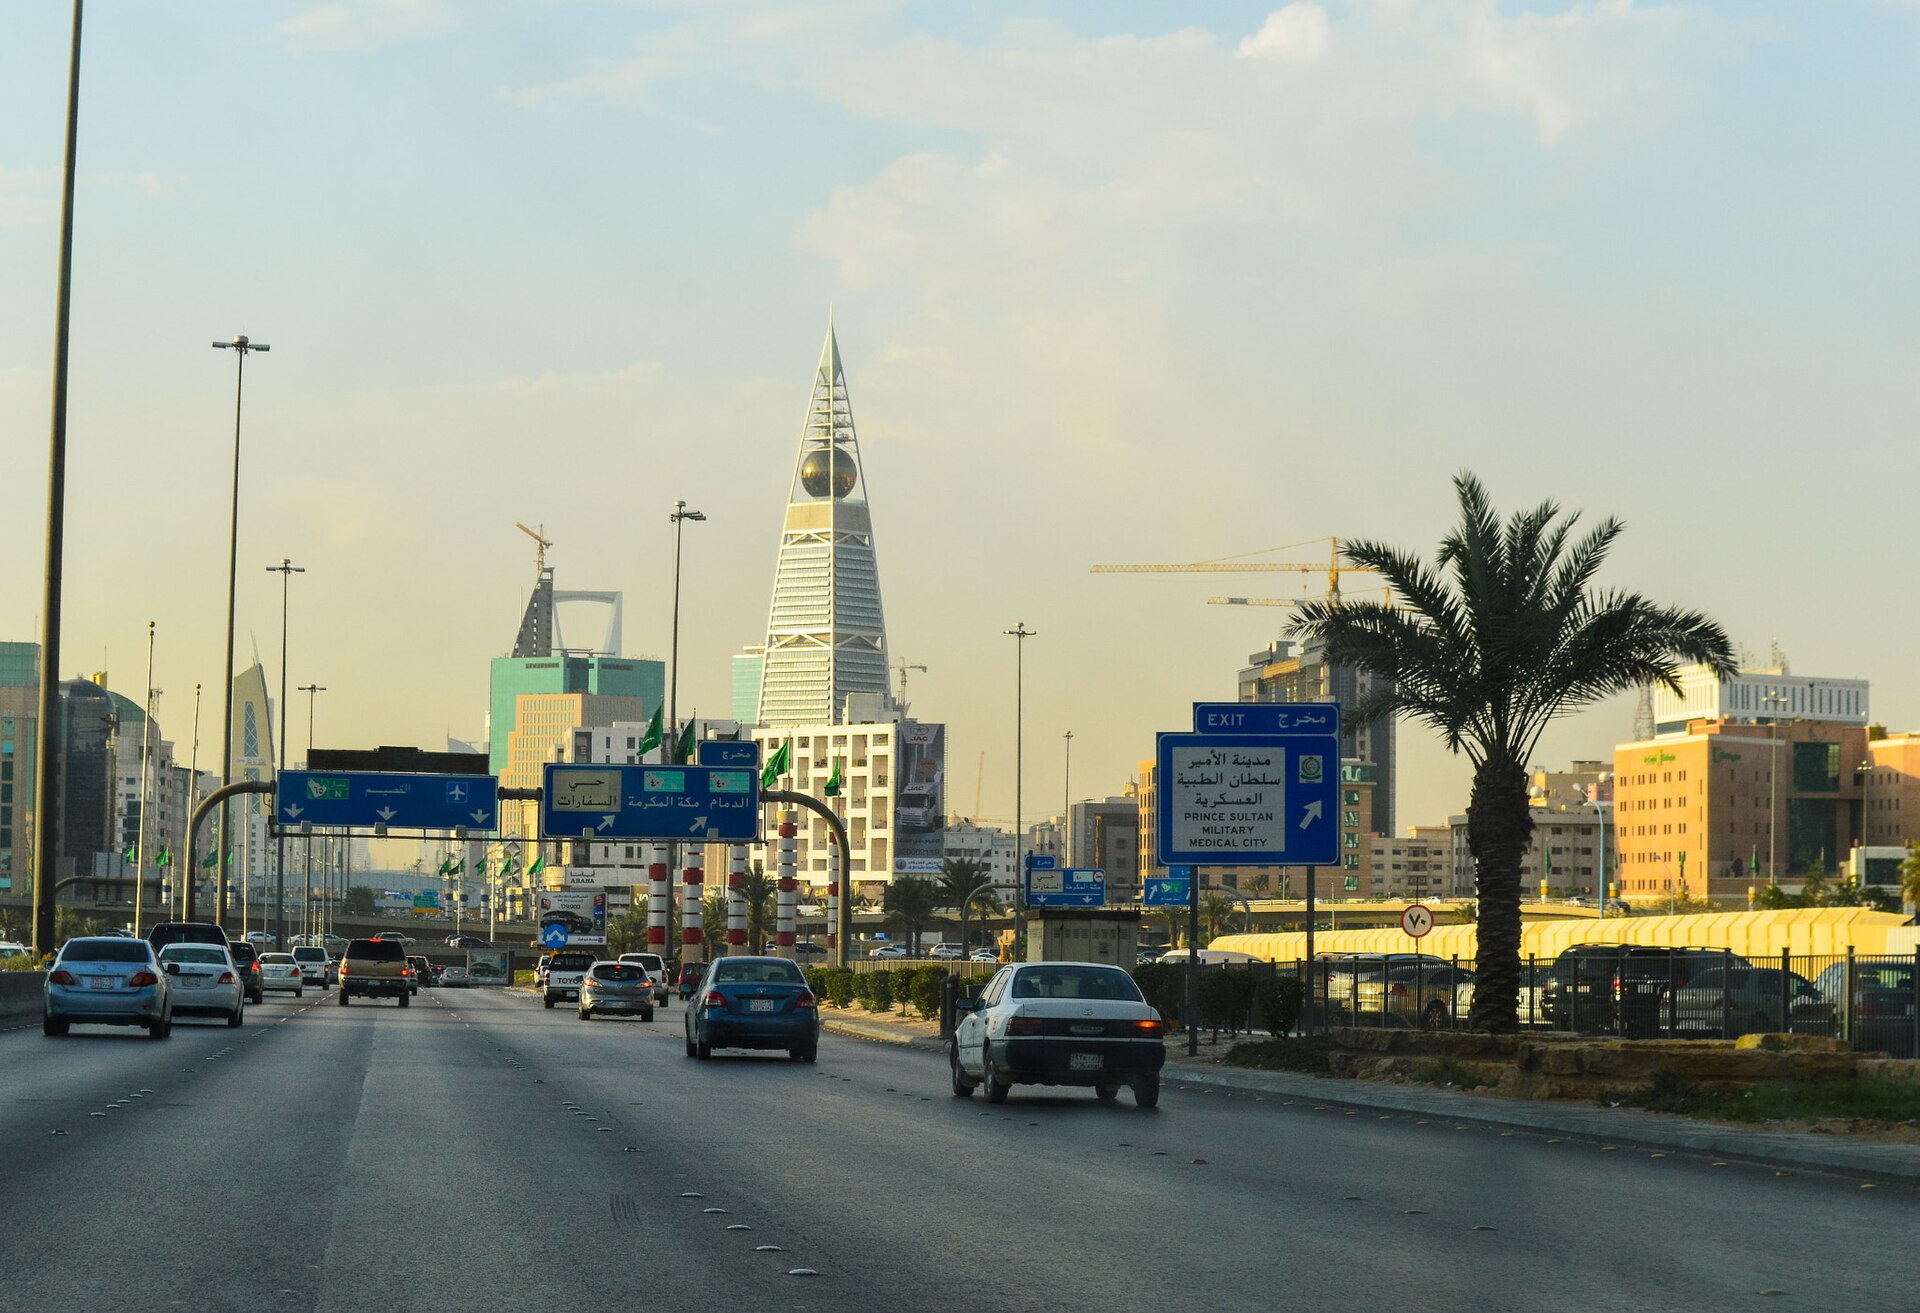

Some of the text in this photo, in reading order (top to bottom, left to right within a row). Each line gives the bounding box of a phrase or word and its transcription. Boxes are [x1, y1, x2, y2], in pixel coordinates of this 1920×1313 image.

[1208, 714, 1245, 726] EXIT
[1278, 712, 1326, 728] مخرج
[722, 749, 750, 760] مخرج
[1188, 749, 1271, 768] مدينة الأمير
[568, 778, 604, 792] حي
[1177, 773, 1280, 788] سلطان الطبية
[365, 784, 410, 798] القصيم
[557, 795, 617, 808] السفارات
[628, 796, 700, 809] مكة المكرمة
[710, 797, 749, 808] الدمام
[1195, 792, 1262, 808] العسكرية
[1184, 812, 1273, 821] PRINCE SULTAN
[1202, 826, 1254, 834] MILITARY
[1190, 839, 1267, 847] MEDICAL CITY
[1409, 912, 1426, 929] ٧٠
